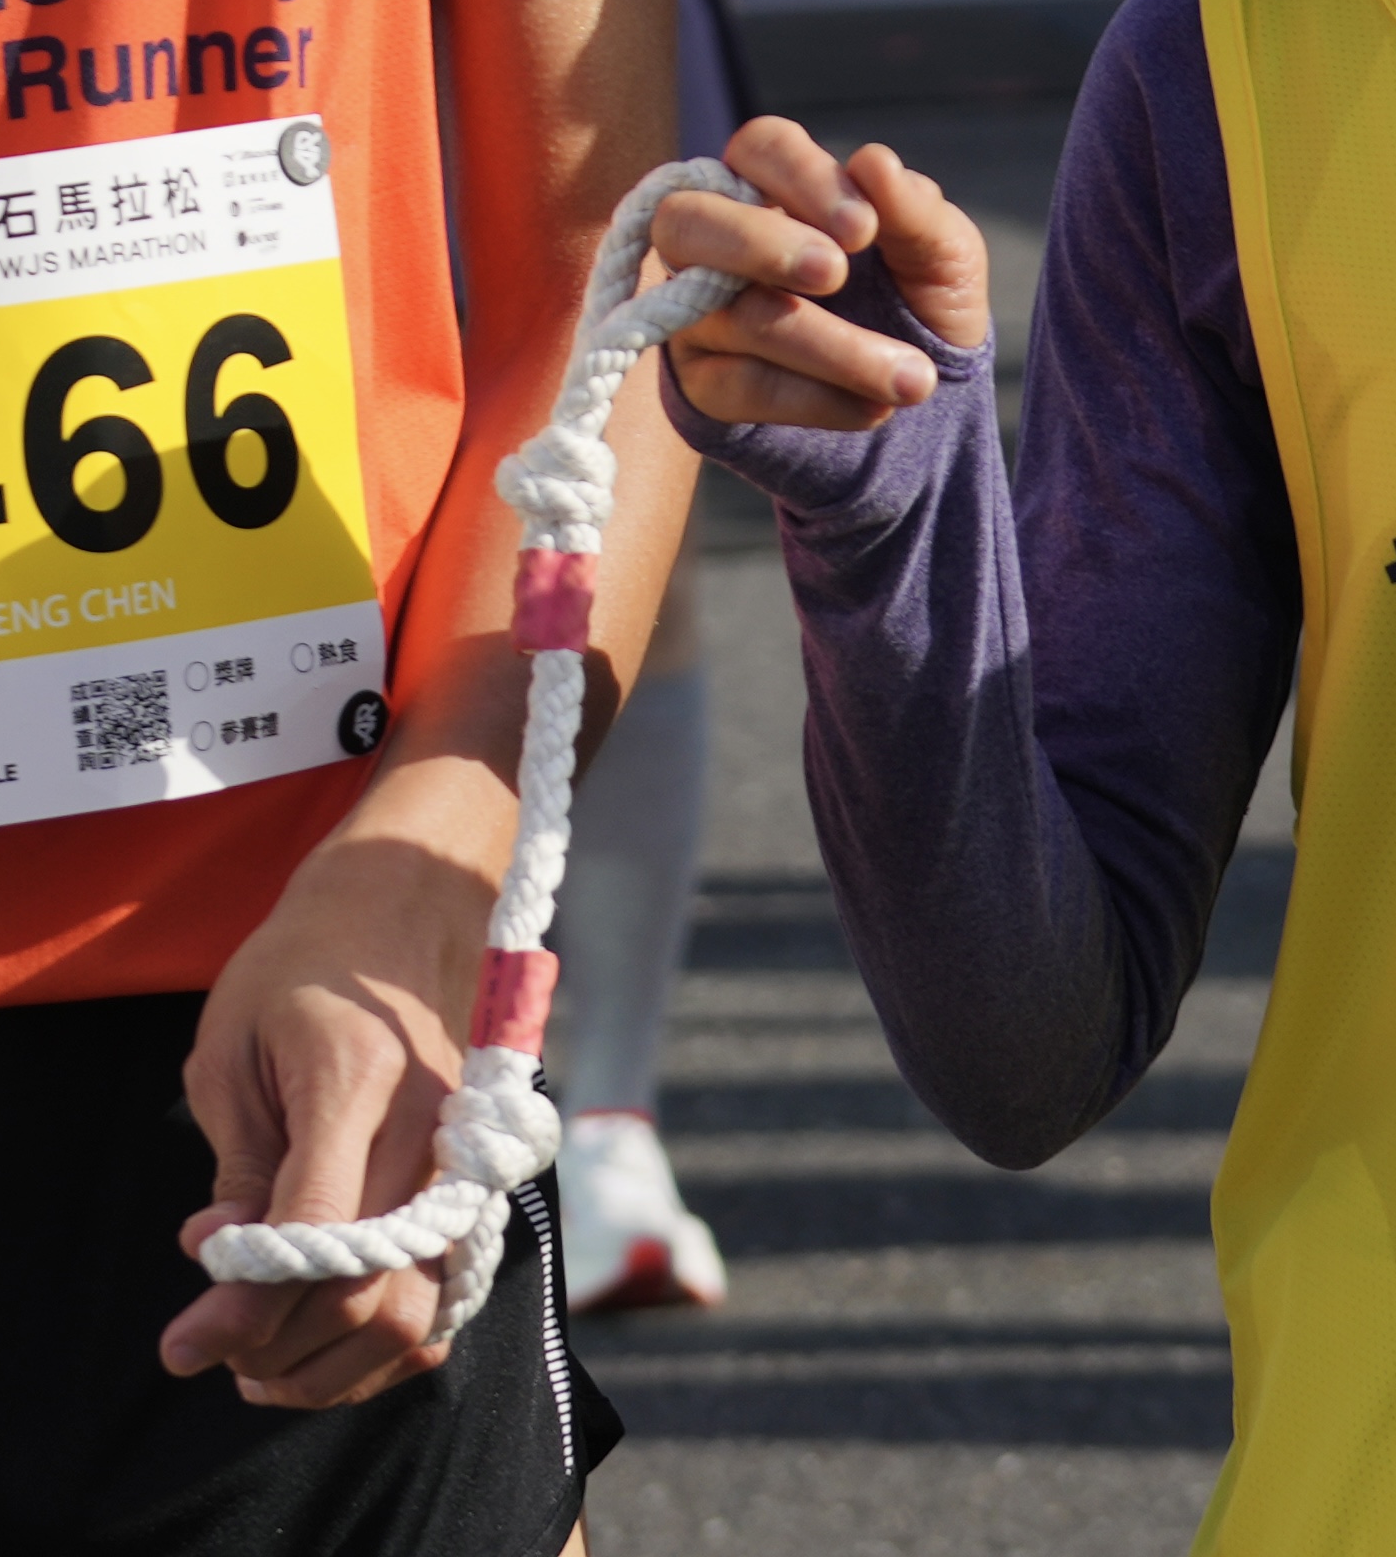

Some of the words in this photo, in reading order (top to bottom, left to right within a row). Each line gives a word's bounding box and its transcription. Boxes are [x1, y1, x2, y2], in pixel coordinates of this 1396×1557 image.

[3, 26, 313, 121] Runner
[68, 229, 209, 272] MARATHON
[79, 578, 177, 623] CHEN
